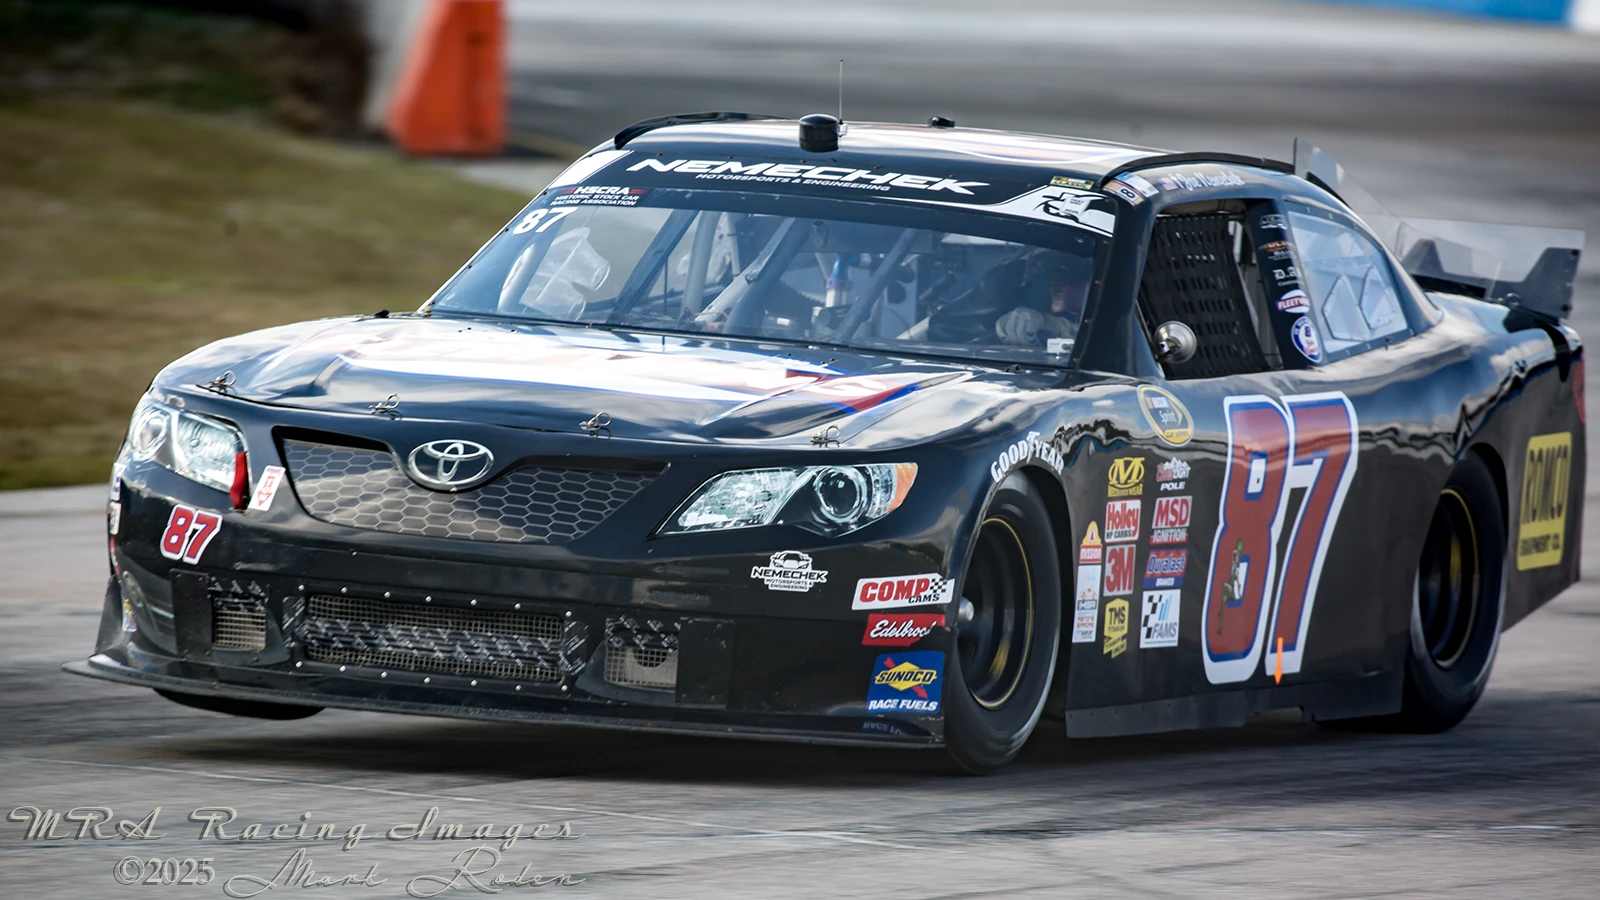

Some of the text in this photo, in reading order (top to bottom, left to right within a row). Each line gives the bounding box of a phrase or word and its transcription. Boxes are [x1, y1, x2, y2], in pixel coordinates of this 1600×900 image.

[625, 158, 991, 195] NEMECHEK
[695, 173, 791, 183] MOTORSPORTS
[802, 179, 891, 191] ENGINEERING
[574, 186, 630, 194] HSCRA
[513, 206, 579, 235] 87
[990, 431, 1064, 483] GOODYEAR
[1160, 481, 1186, 491] POLE
[1521, 444, 1569, 524] ROMCO
[1106, 502, 1139, 537] Holley
[1154, 498, 1190, 528] MSD
[160, 504, 223, 565] 87
[1105, 529, 1132, 539] HP CARBS
[1152, 528, 1187, 543] IGNITION
[1201, 391, 1359, 684] 87
[1105, 546, 1135, 592] 3M
[1147, 553, 1186, 573] Duralast
[752, 568, 828, 582] NEMECHEK
[860, 578, 930, 603] COMP
[908, 594, 940, 604] CAMS
[1108, 606, 1126, 626] TMS
[1151, 622, 1178, 639] FAMS
[877, 671, 935, 683] SUNOCO
[868, 699, 938, 712] RACE FUELS
